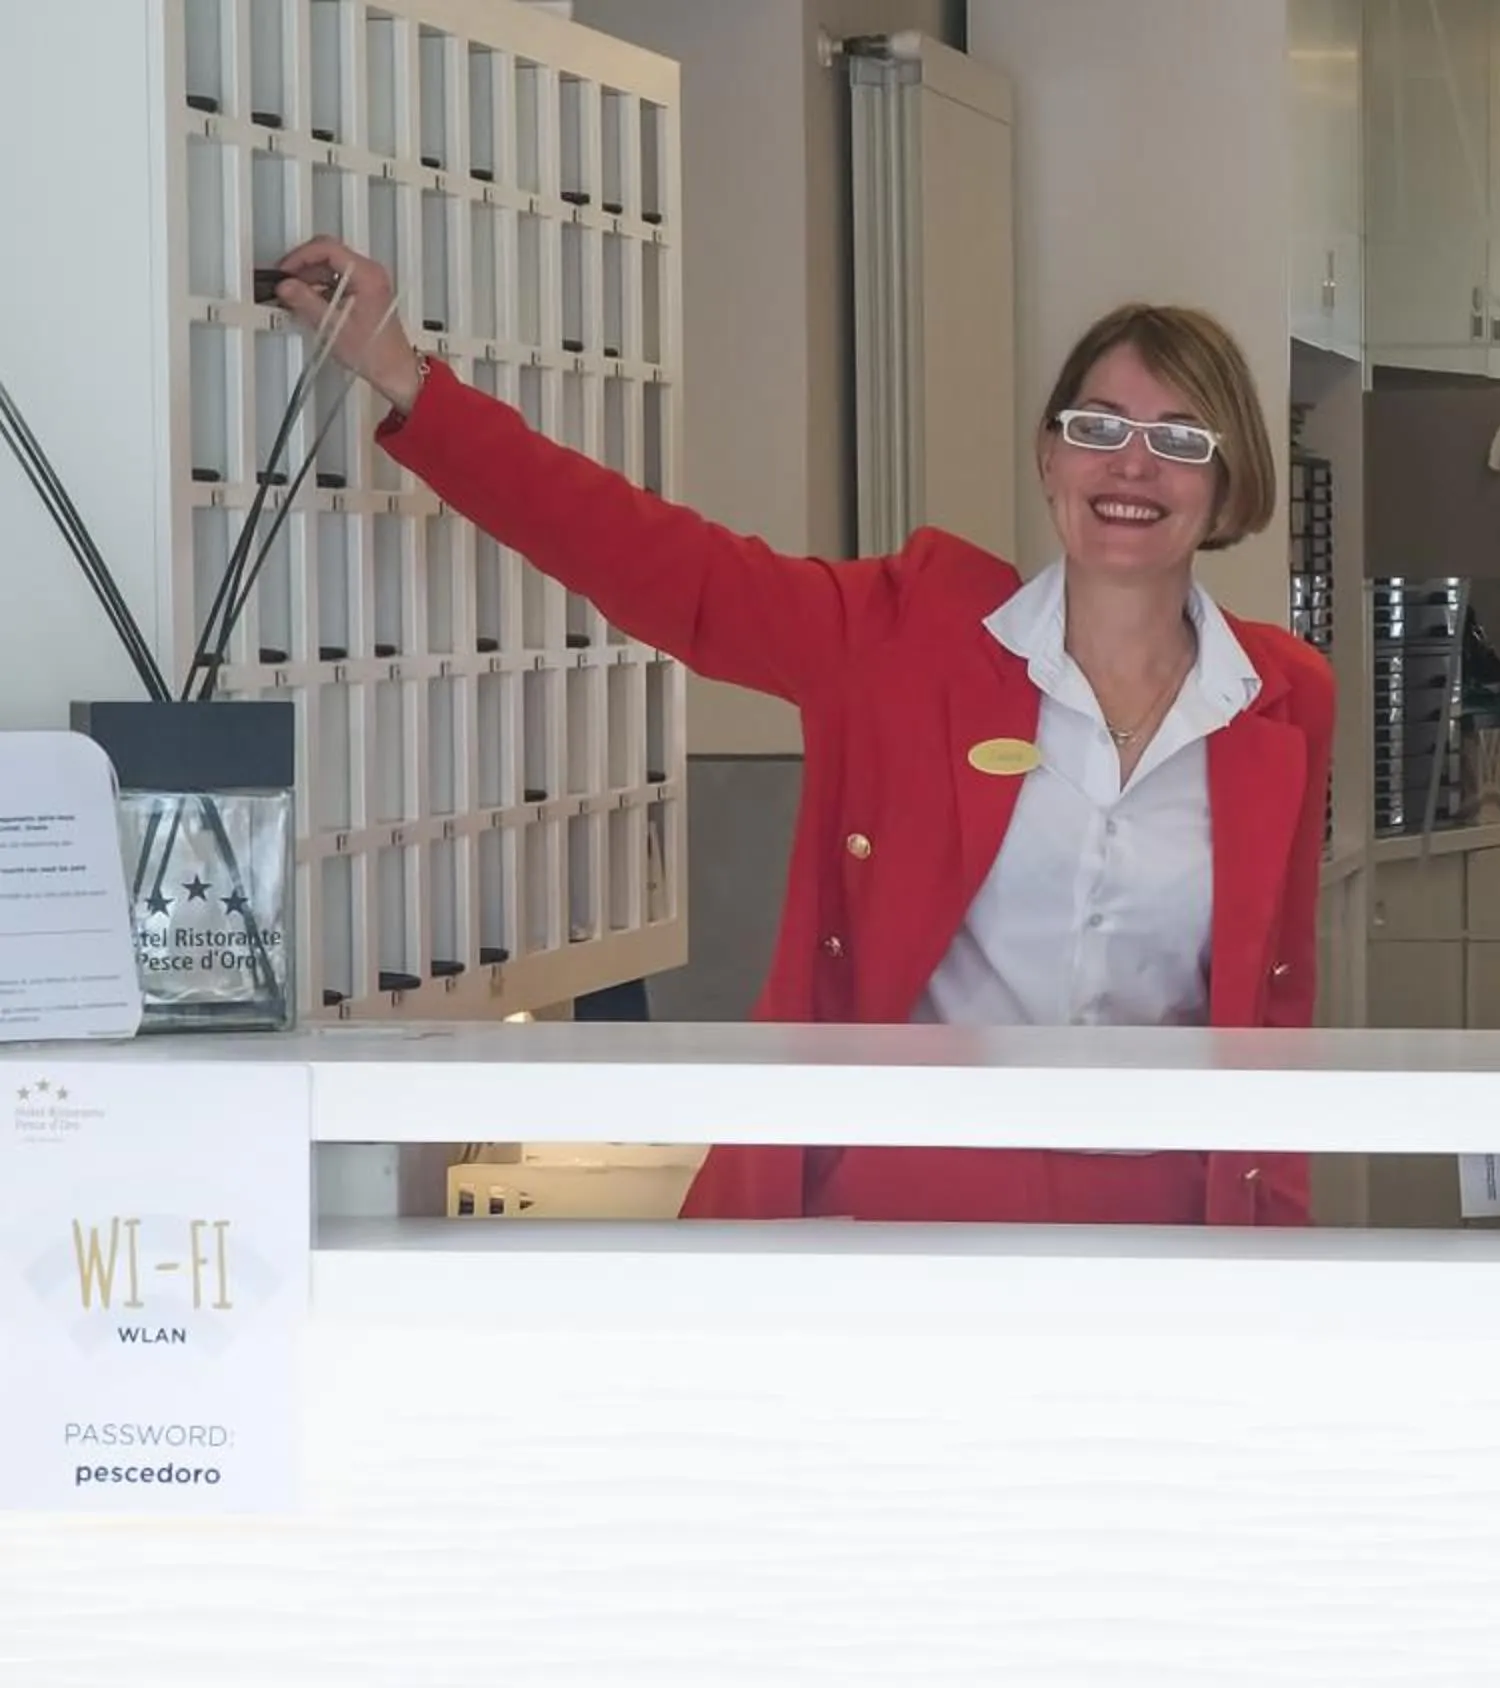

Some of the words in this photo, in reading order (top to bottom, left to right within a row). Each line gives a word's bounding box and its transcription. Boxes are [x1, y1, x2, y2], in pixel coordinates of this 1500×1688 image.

[72, 1216, 233, 1311] WI-FI
[118, 1327, 187, 1344] WLAN
[65, 1423, 235, 1448] PASSWORD:
[75, 1463, 221, 1486] pescedoro
